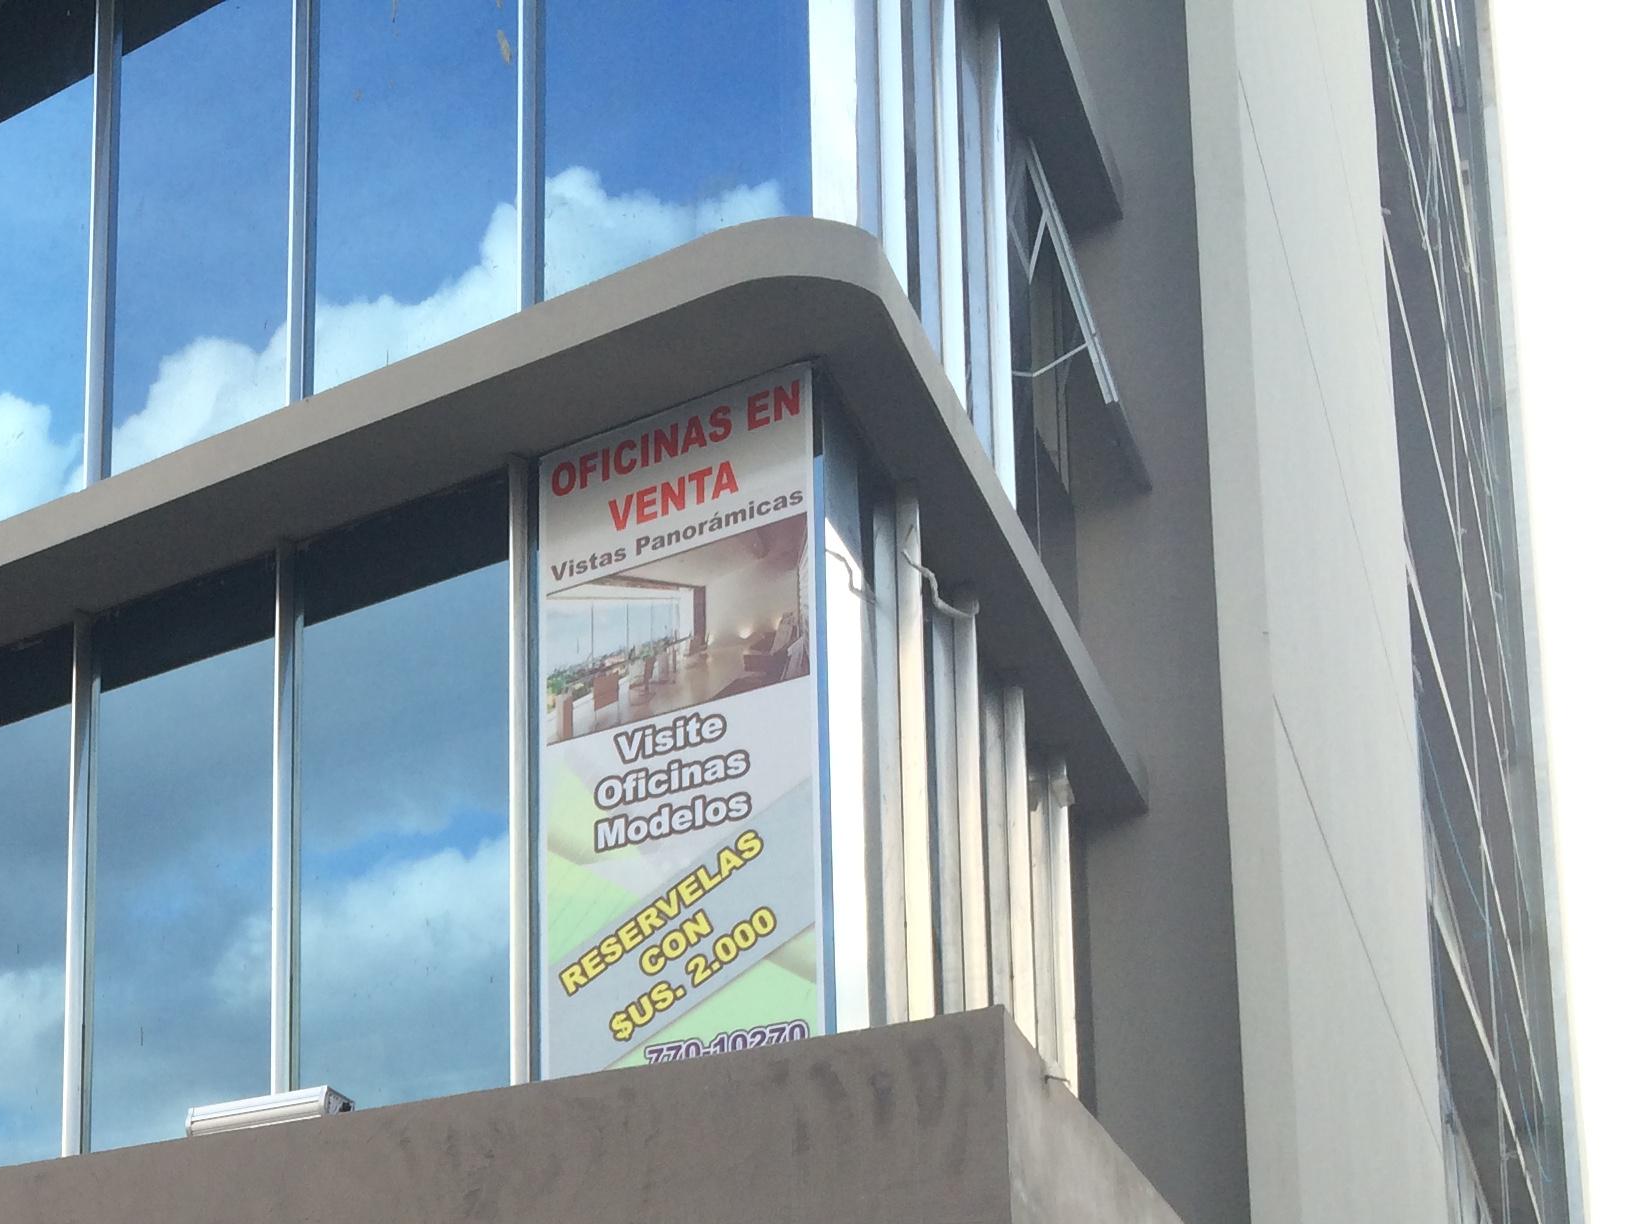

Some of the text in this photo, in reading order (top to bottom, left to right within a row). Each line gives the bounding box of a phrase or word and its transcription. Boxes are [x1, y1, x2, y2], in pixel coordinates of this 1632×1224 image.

[551, 379, 801, 497] OFICINAS EN
[608, 460, 740, 533] VENTA
[551, 490, 804, 582] Vistas Panorámicas
[613, 712, 726, 762] Visite
[594, 749, 750, 811] Oficinas
[594, 791, 752, 853] Modelos
[558, 829, 763, 994] RESERVELAS
[639, 908, 713, 977] CON
[609, 906, 777, 1042] $US. 2.000
